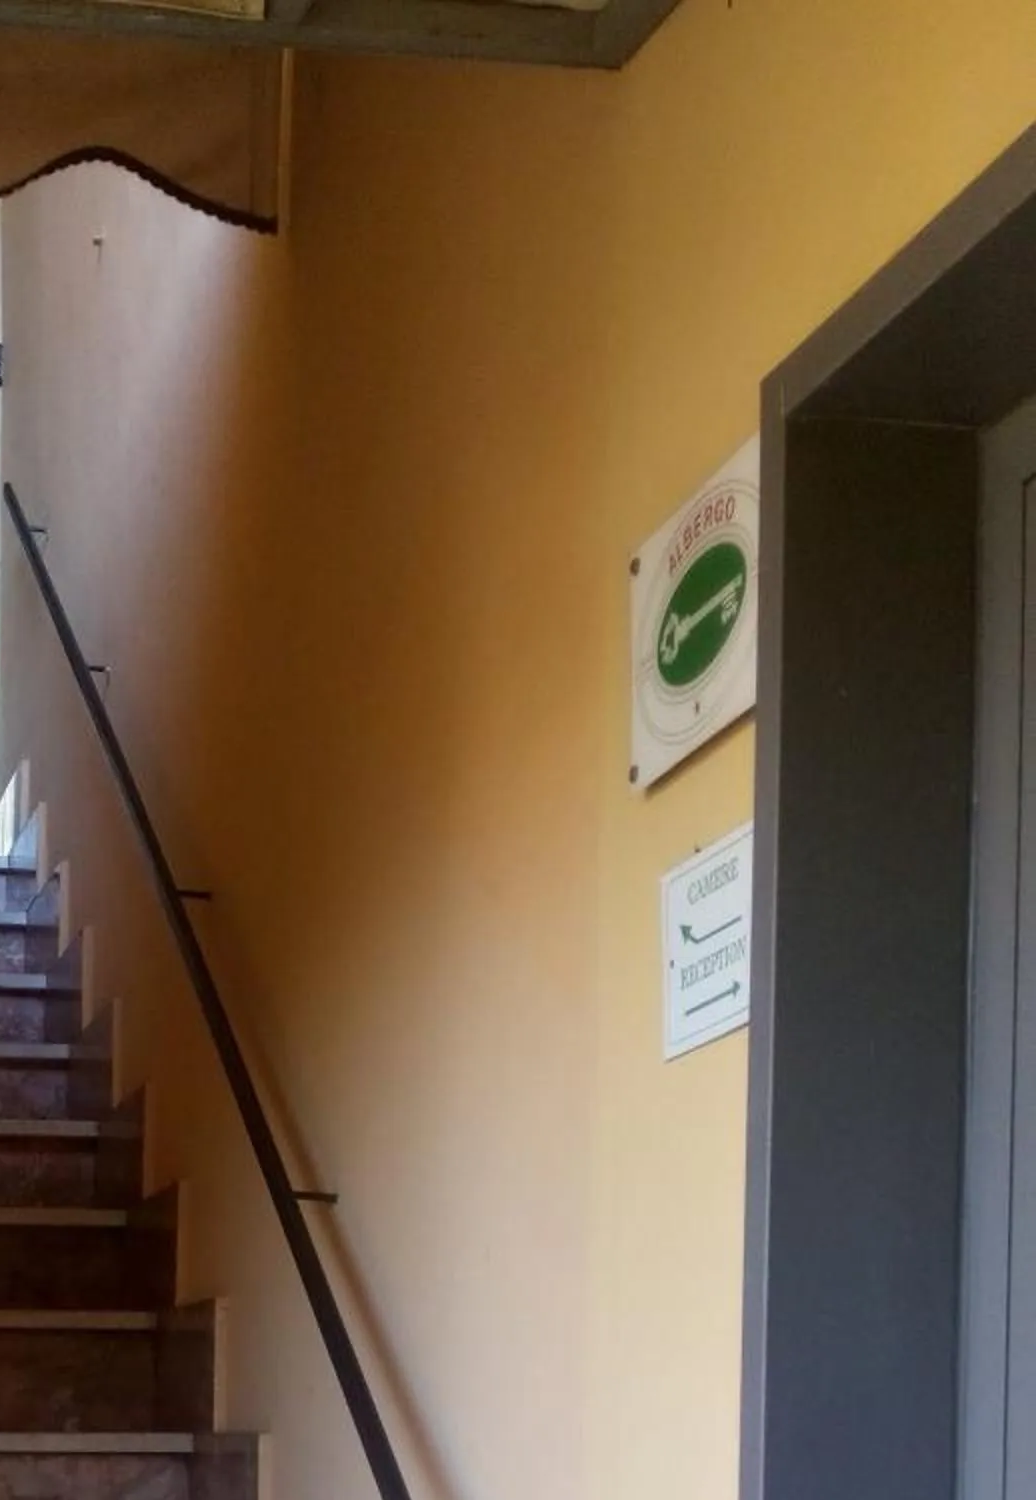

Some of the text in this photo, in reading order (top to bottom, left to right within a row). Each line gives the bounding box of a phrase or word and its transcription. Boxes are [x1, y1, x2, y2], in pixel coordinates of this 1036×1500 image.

[669, 495, 736, 575] ALBERGO
[686, 855, 740, 905] CAMERE
[679, 934, 748, 991] RECEPTION
